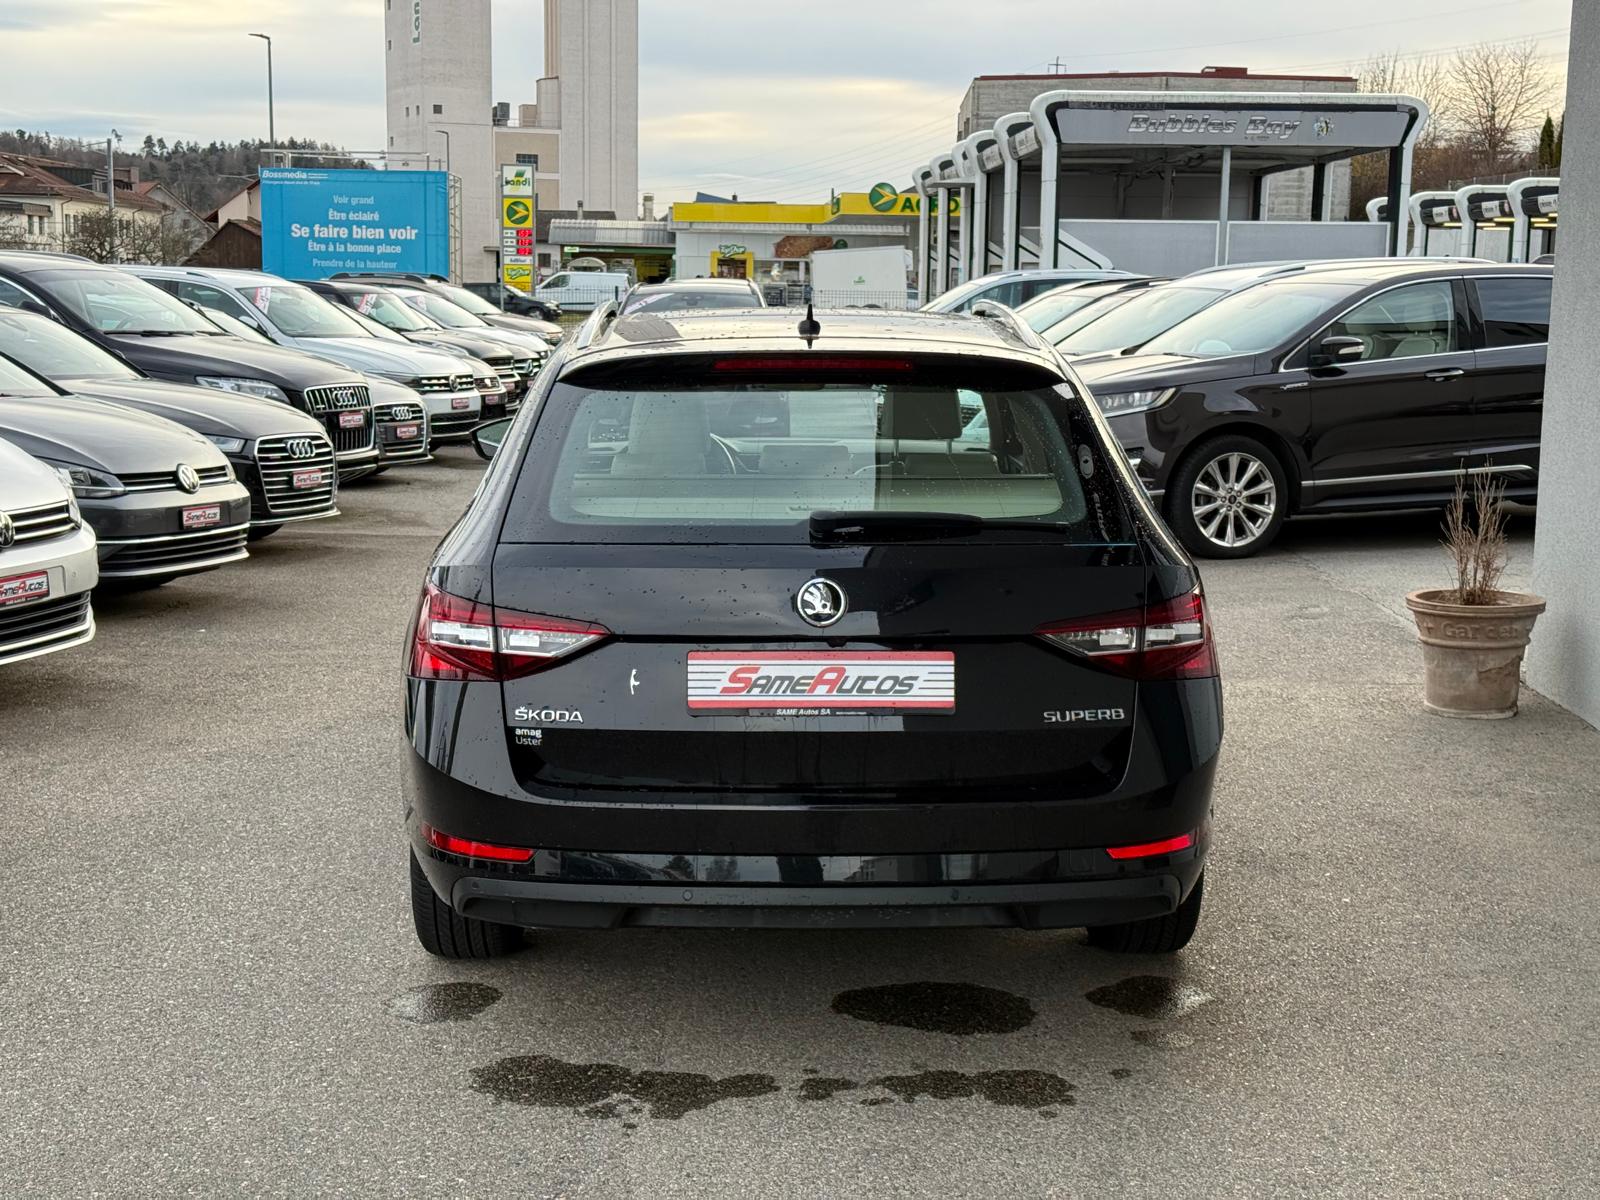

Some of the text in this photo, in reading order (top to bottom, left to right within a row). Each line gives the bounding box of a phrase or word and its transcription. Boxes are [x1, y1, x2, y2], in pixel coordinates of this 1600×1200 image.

[1128, 115, 1302, 140] Bubbles Bay
[262, 169, 307, 179] Bossmedia
[333, 195, 374, 206] Voir grand
[328, 208, 380, 222] Être éclairé
[290, 223, 419, 241] Se faire bien voir
[308, 240, 402, 255] Être à la bonne place
[312, 258, 398, 270] Prendre de la hauteur
[514, 706, 584, 723] ŠKODA
[776, 708, 798, 716] SAME
[798, 708, 819, 716] Autos
[820, 708, 831, 716] SA
[1043, 708, 1125, 723] SUPERB
[515, 729, 543, 739] amag
[515, 736, 543, 746] Uster
